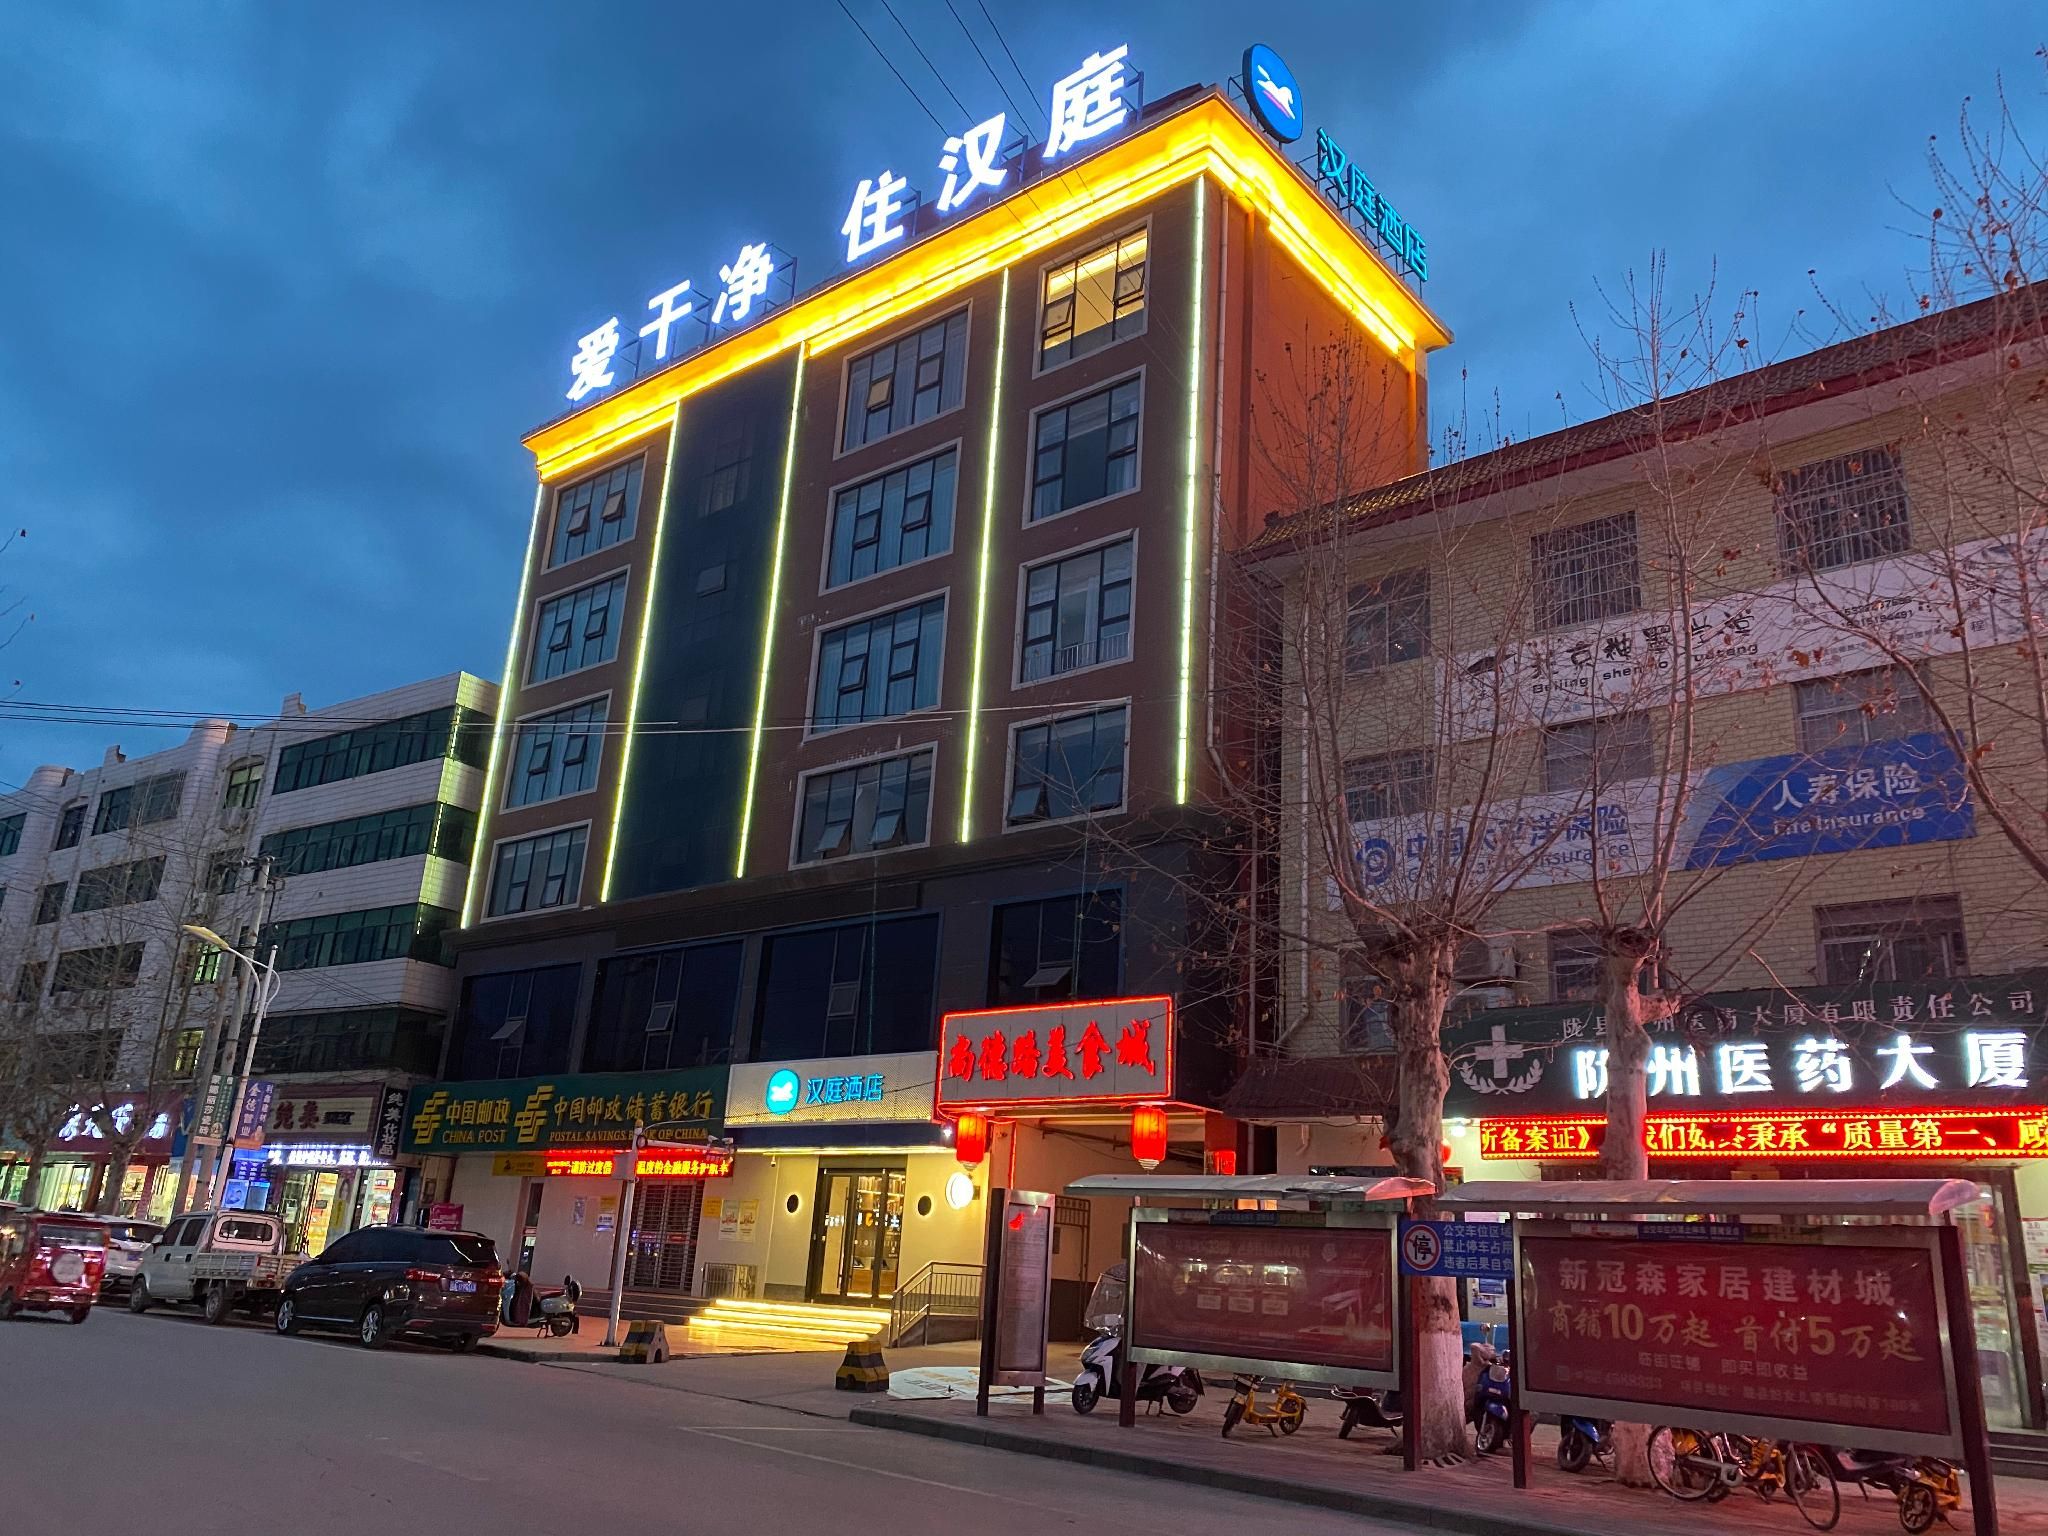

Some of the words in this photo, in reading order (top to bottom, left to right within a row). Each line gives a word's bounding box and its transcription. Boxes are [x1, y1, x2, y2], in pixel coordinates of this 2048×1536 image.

[1317, 127, 1428, 282] 汉庭酒店
[566, 242, 775, 401] 爱干净
[841, 43, 1129, 263] 住汉庭
[1772, 762, 1921, 812] 人寿保险
[1816, 806, 1926, 832] Insurance
[805, 1073, 884, 1104] 汉庭酒店
[446, 1098, 511, 1126] 中国邮政
[553, 1090, 715, 1127] 中国邮政储蓄银行
[442, 1129, 474, 1144] CHINA
[478, 1128, 507, 1143] POST
[549, 1132, 584, 1142] POSTAL
[586, 1130, 626, 1141] SAVINGS
[674, 1127, 709, 1140] CHINA
[1412, 1235, 1433, 1260] 停
[1443, 1239, 1513, 1254] 禁止停车占用
[1444, 1256, 1513, 1271] 违者后果自负
[1559, 1257, 1895, 1306] 新冠森家居建材城
